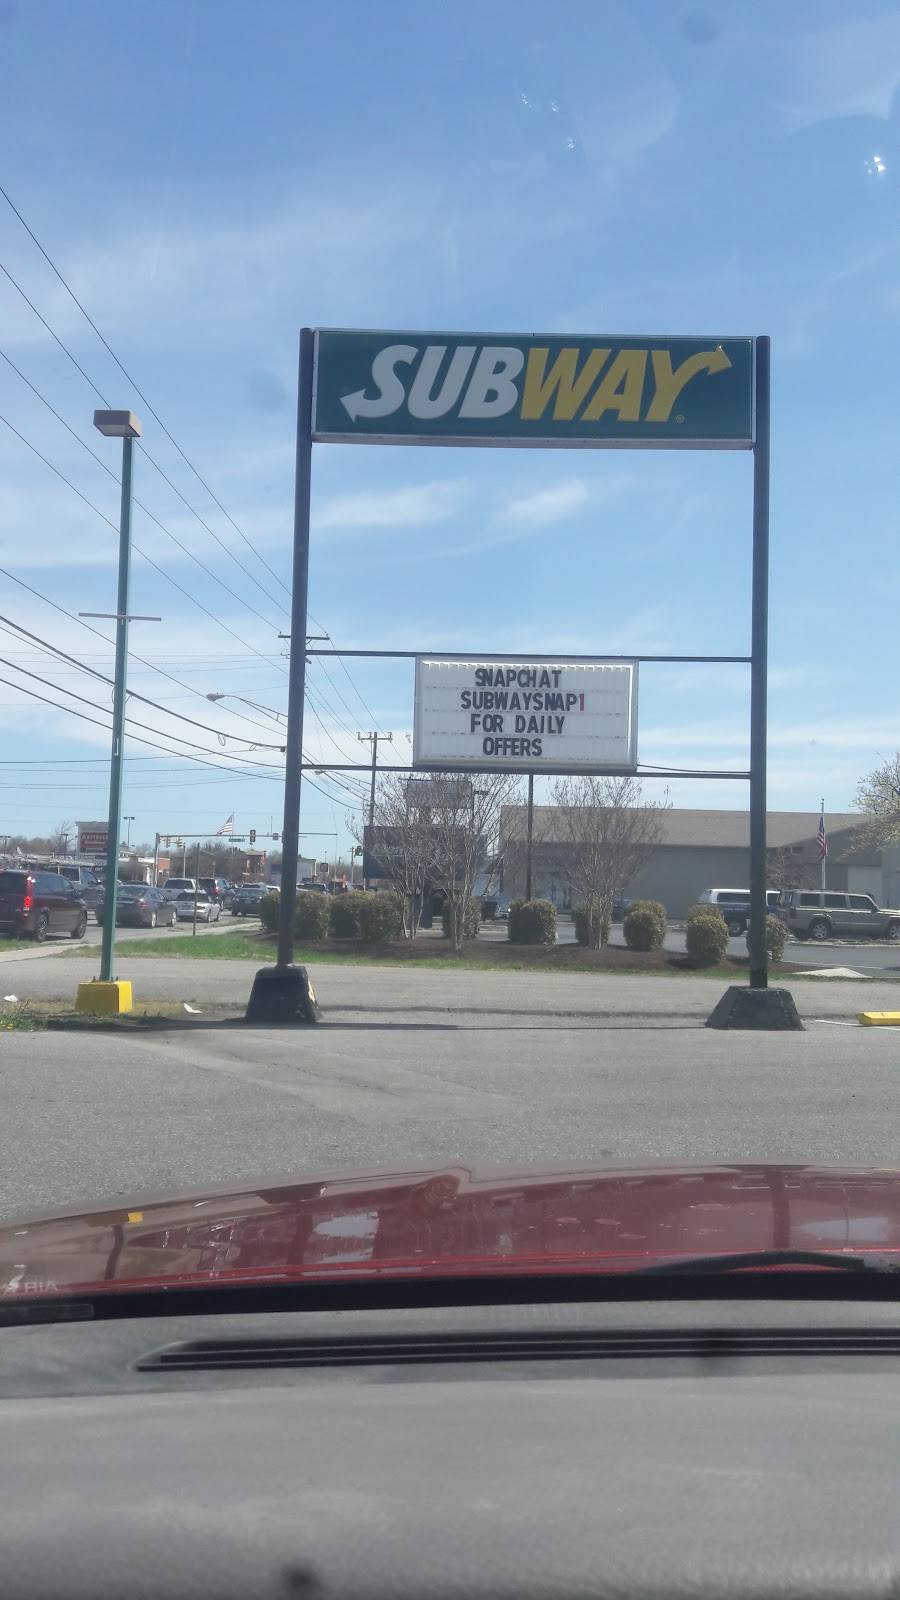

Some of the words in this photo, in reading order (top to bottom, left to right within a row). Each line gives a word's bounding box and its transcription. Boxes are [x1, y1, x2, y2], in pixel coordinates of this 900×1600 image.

[340, 344, 732, 422] SUBWAY
[475, 668, 562, 688] SNAPCHAT
[470, 714, 504, 733] FOR
[515, 716, 565, 734] DAILY
[482, 737, 543, 756] OFFERS
